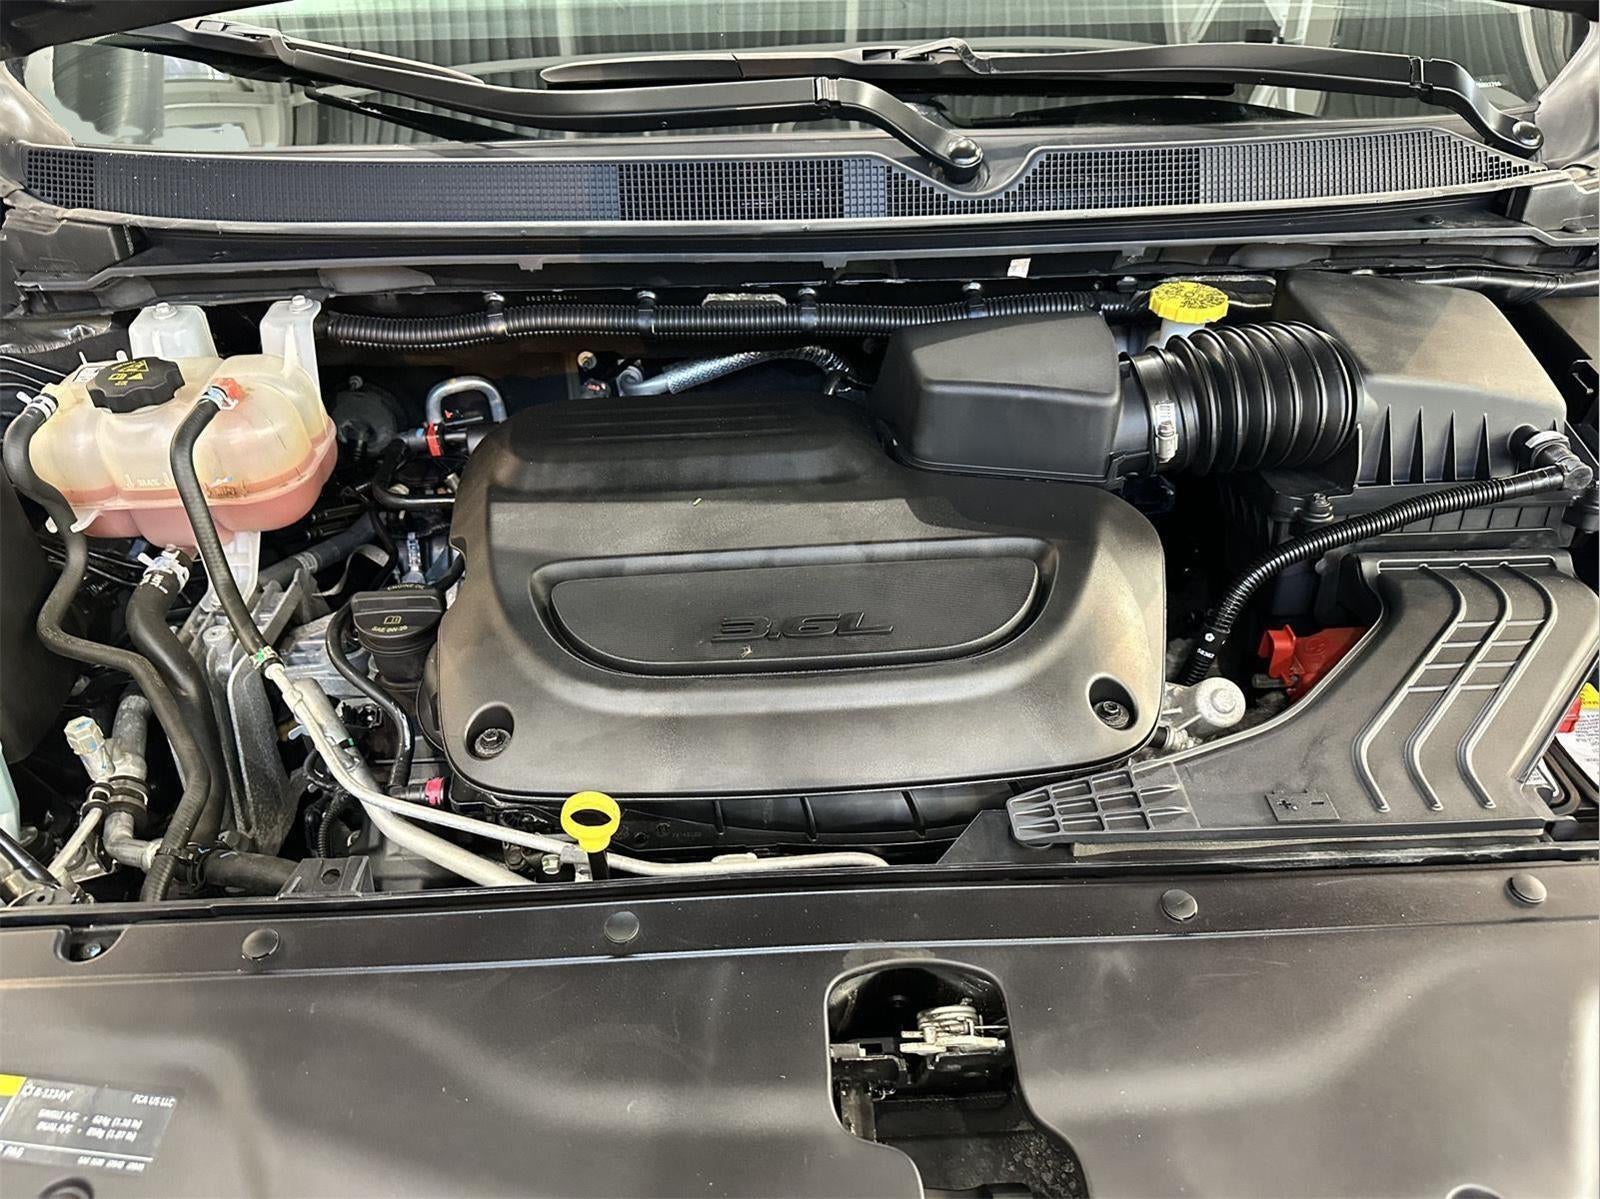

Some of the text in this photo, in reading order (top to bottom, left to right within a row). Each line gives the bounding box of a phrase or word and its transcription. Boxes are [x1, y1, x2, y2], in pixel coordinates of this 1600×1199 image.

[371, 625, 386, 633] SAE
[711, 611, 894, 643] 3.6L
[132, 1094, 176, 1108] FCA US LLC
